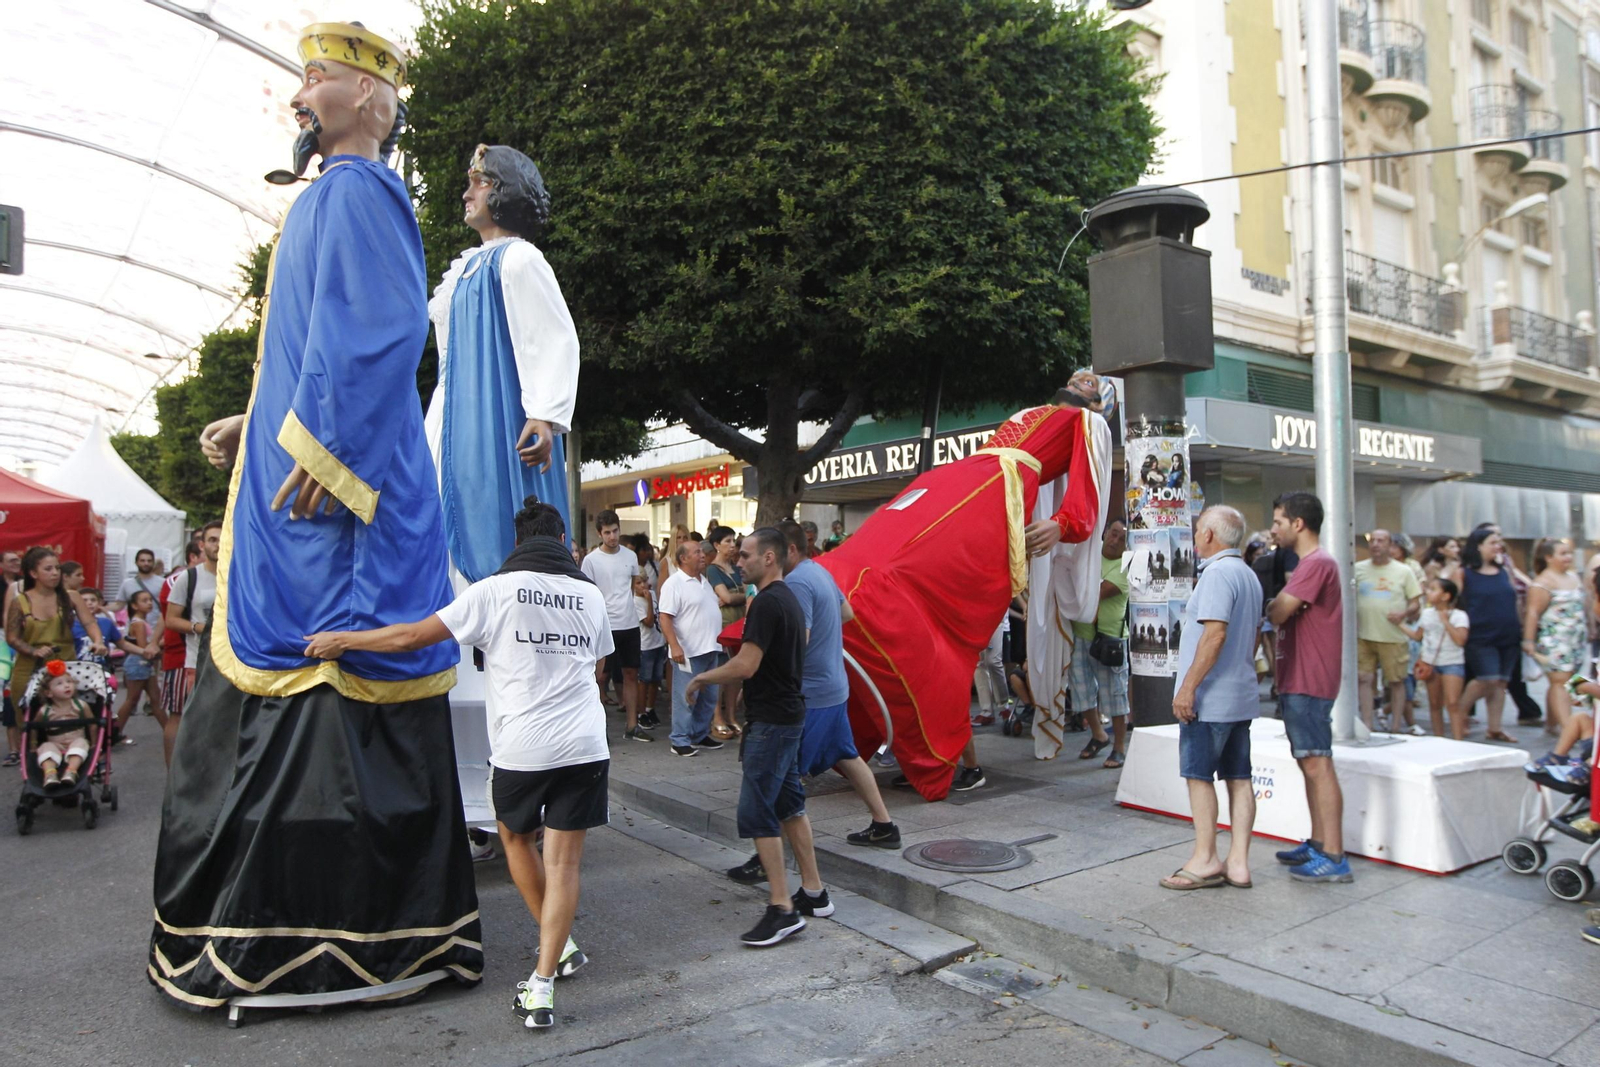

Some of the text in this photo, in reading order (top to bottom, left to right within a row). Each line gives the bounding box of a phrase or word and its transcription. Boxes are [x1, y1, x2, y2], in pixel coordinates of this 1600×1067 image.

[1359, 427, 1435, 463] REGENTE
[652, 462, 730, 500] Soloptical
[803, 450, 879, 485] OYERIA
[517, 588, 585, 611] GIGANTE
[515, 630, 591, 649] LUPION
[1252, 775, 1274, 787] NTA
